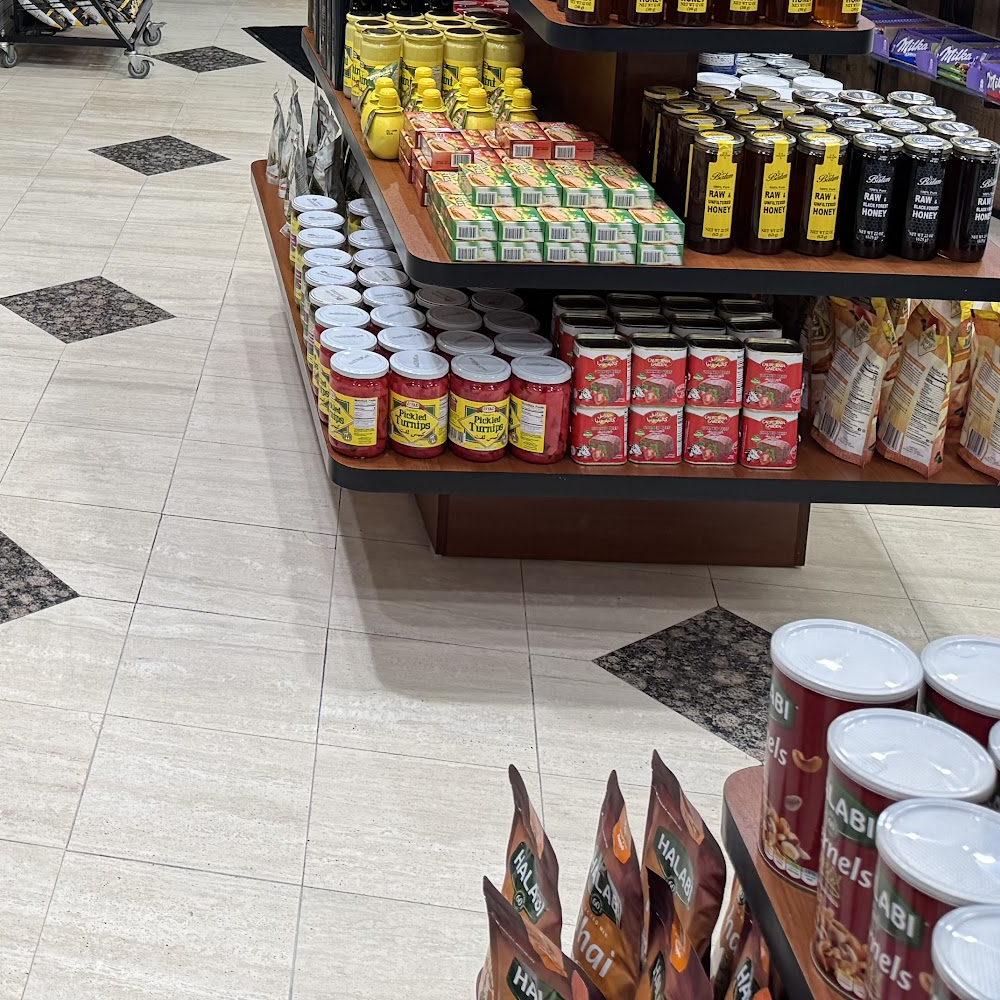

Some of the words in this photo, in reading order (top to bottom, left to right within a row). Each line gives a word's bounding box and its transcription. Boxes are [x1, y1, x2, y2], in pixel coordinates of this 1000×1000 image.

[896, 37, 928, 54] Milka
[940, 46, 972, 63] Milka
[709, 190, 726, 198] RAW
[765, 191, 780, 199] RAW
[864, 192, 881, 201] RAW
[914, 194, 933, 204] RAW
[707, 205, 731, 214] HONEY
[763, 206, 786, 214] HONEY
[812, 208, 836, 216] HONEY
[861, 207, 888, 218] HONEY
[912, 210, 938, 220] HONEY
[399, 409, 427, 421] Pickled
[474, 415, 501, 424] Pickled
[395, 414, 431, 431] Turnips
[469, 422, 503, 434] Turnips
[658, 833, 693, 903] HALABI
[513, 849, 545, 917] HALABI
[590, 857, 622, 917] HALABI
